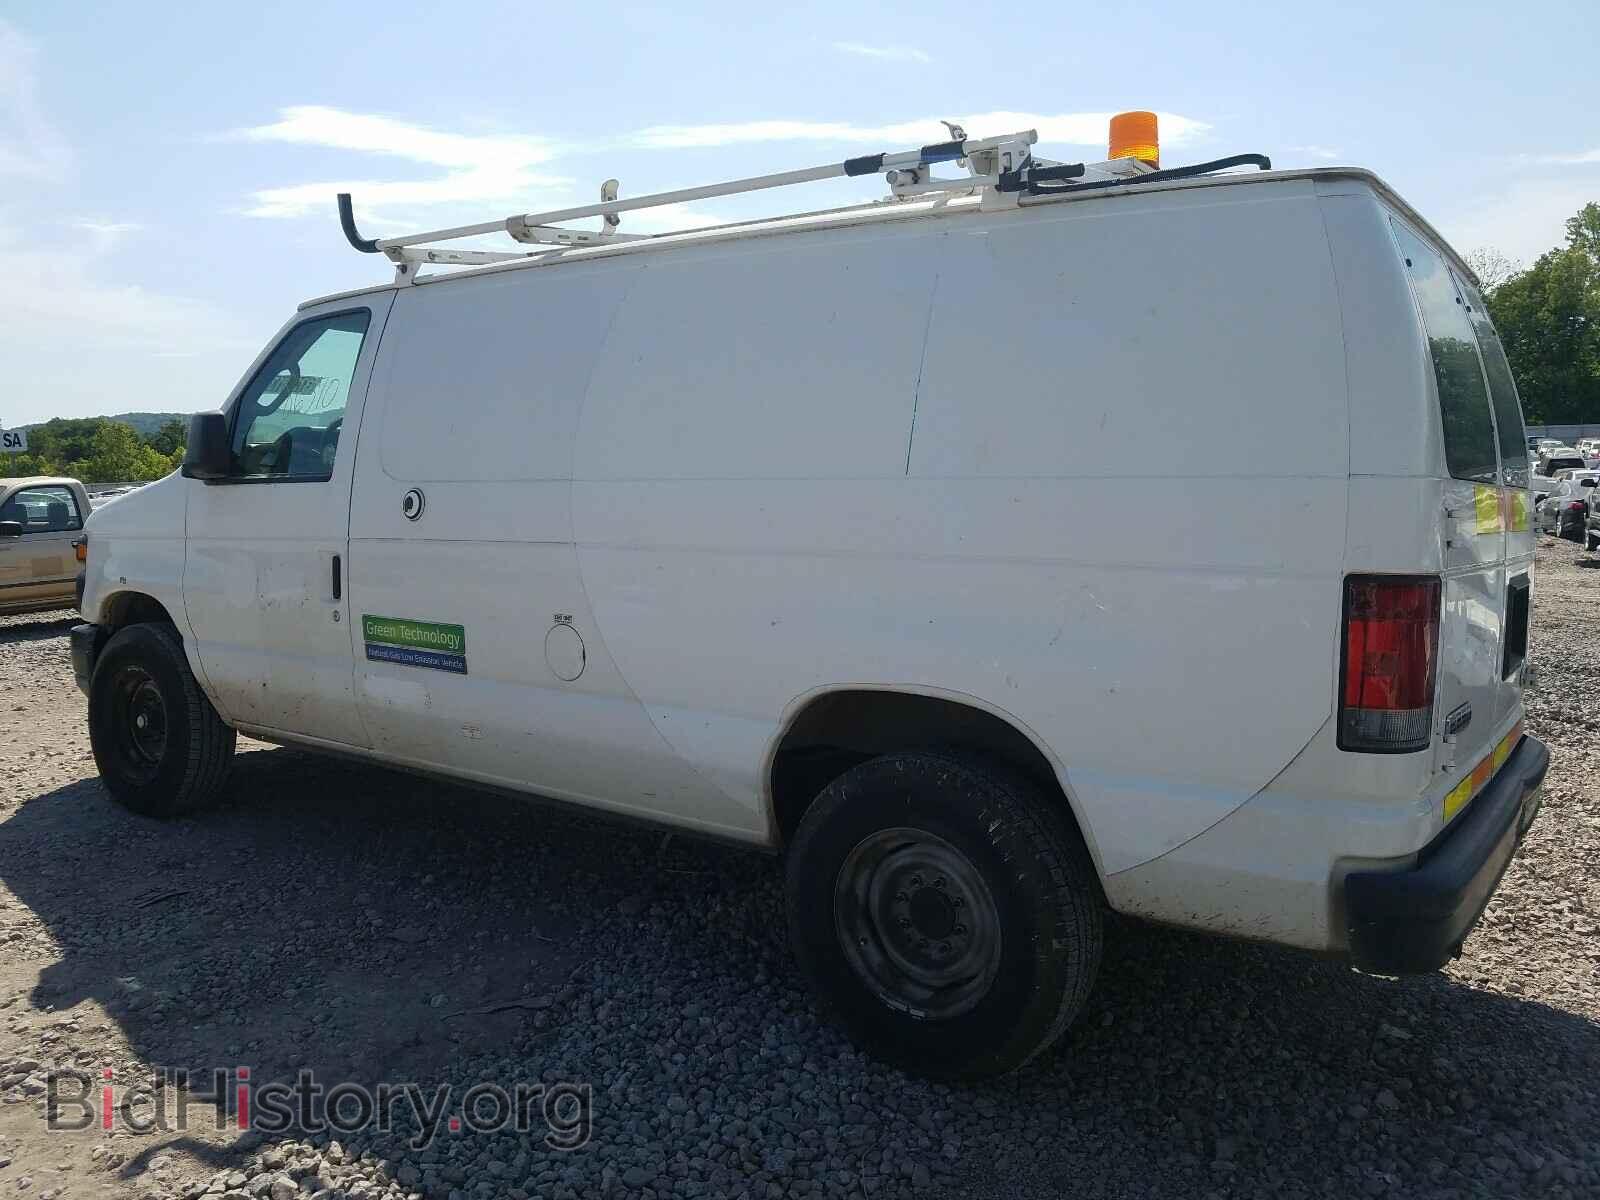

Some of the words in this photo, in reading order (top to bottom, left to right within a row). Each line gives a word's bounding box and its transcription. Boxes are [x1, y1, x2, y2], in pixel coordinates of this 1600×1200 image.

[2, 432, 22, 448] SA
[366, 621, 396, 638] Green
[399, 625, 460, 650] Technology
[414, 654, 440, 666] Emission
